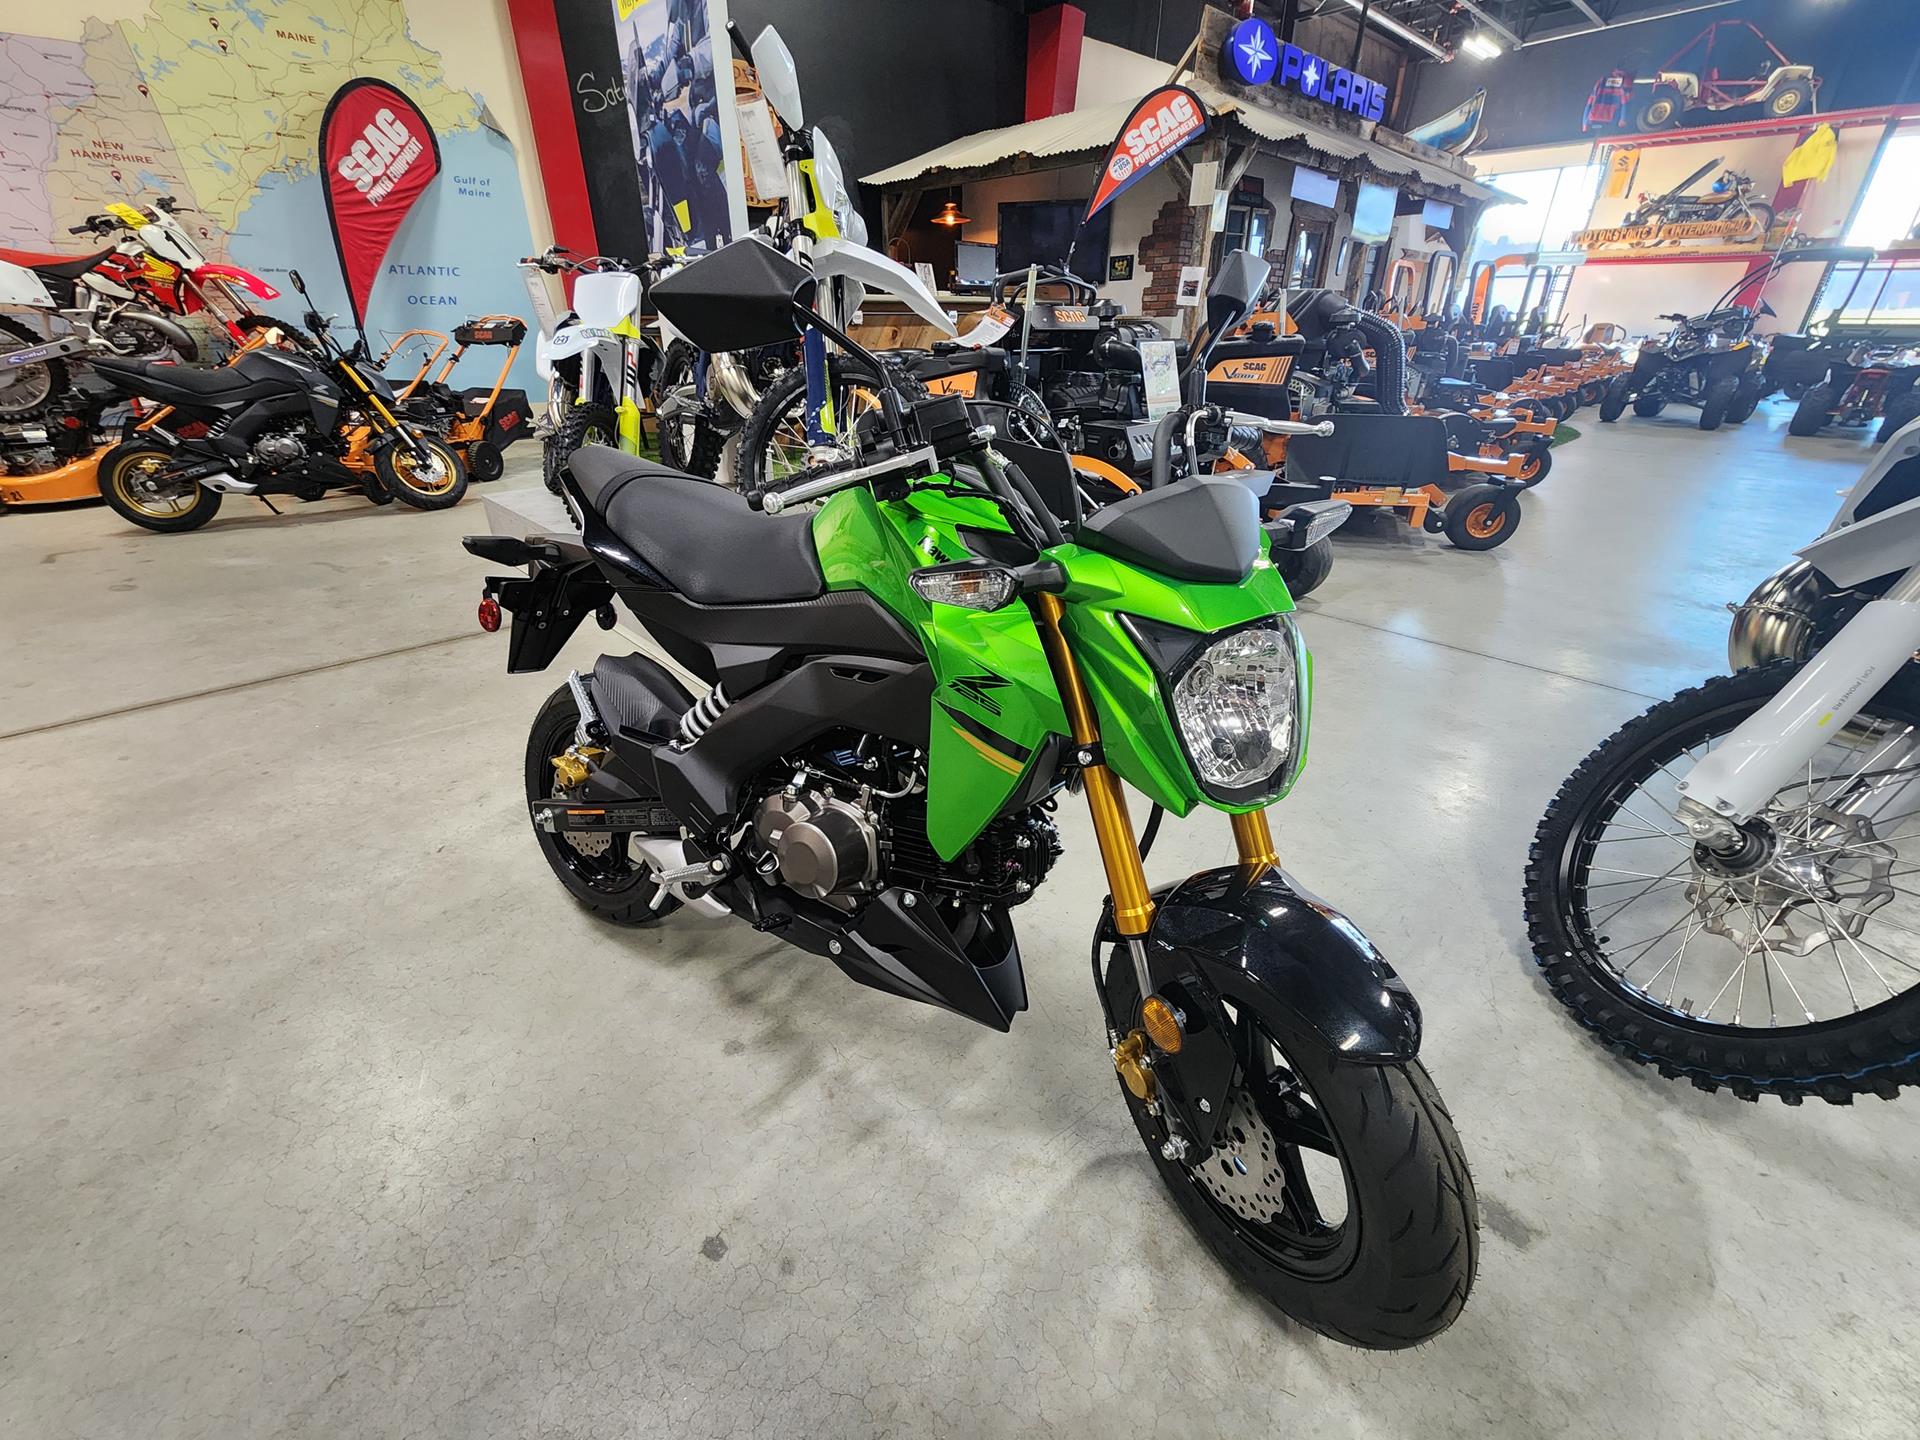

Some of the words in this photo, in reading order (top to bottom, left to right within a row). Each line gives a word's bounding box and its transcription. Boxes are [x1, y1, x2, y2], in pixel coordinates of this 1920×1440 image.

[276, 30, 316, 44] MAINE
[1281, 42, 1388, 123] POLARIS
[0, 105, 37, 113] ONTPELIER
[1124, 95, 1194, 155] SCAG
[92, 140, 124, 151] NEW
[1133, 142, 1160, 167] POWER
[1158, 115, 1199, 149] EQUIPMENT
[70, 149, 154, 165] HAMPSHIRE
[338, 108, 410, 192] SCAG
[1117, 158, 1130, 170] USA
[366, 176, 396, 207] POWER
[386, 136, 424, 183] EQUIPMENT
[453, 175, 476, 186] Gulf
[480, 178, 491, 186] of
[458, 187, 491, 198] Maine
[164, 230, 191, 260] 1
[388, 264, 461, 277] ATLANTIC
[407, 295, 458, 306] OCEAN
[1054, 309, 1087, 324] SCAG
[1243, 362, 1267, 372] SCAG
[916, 534, 951, 564] Kaw
